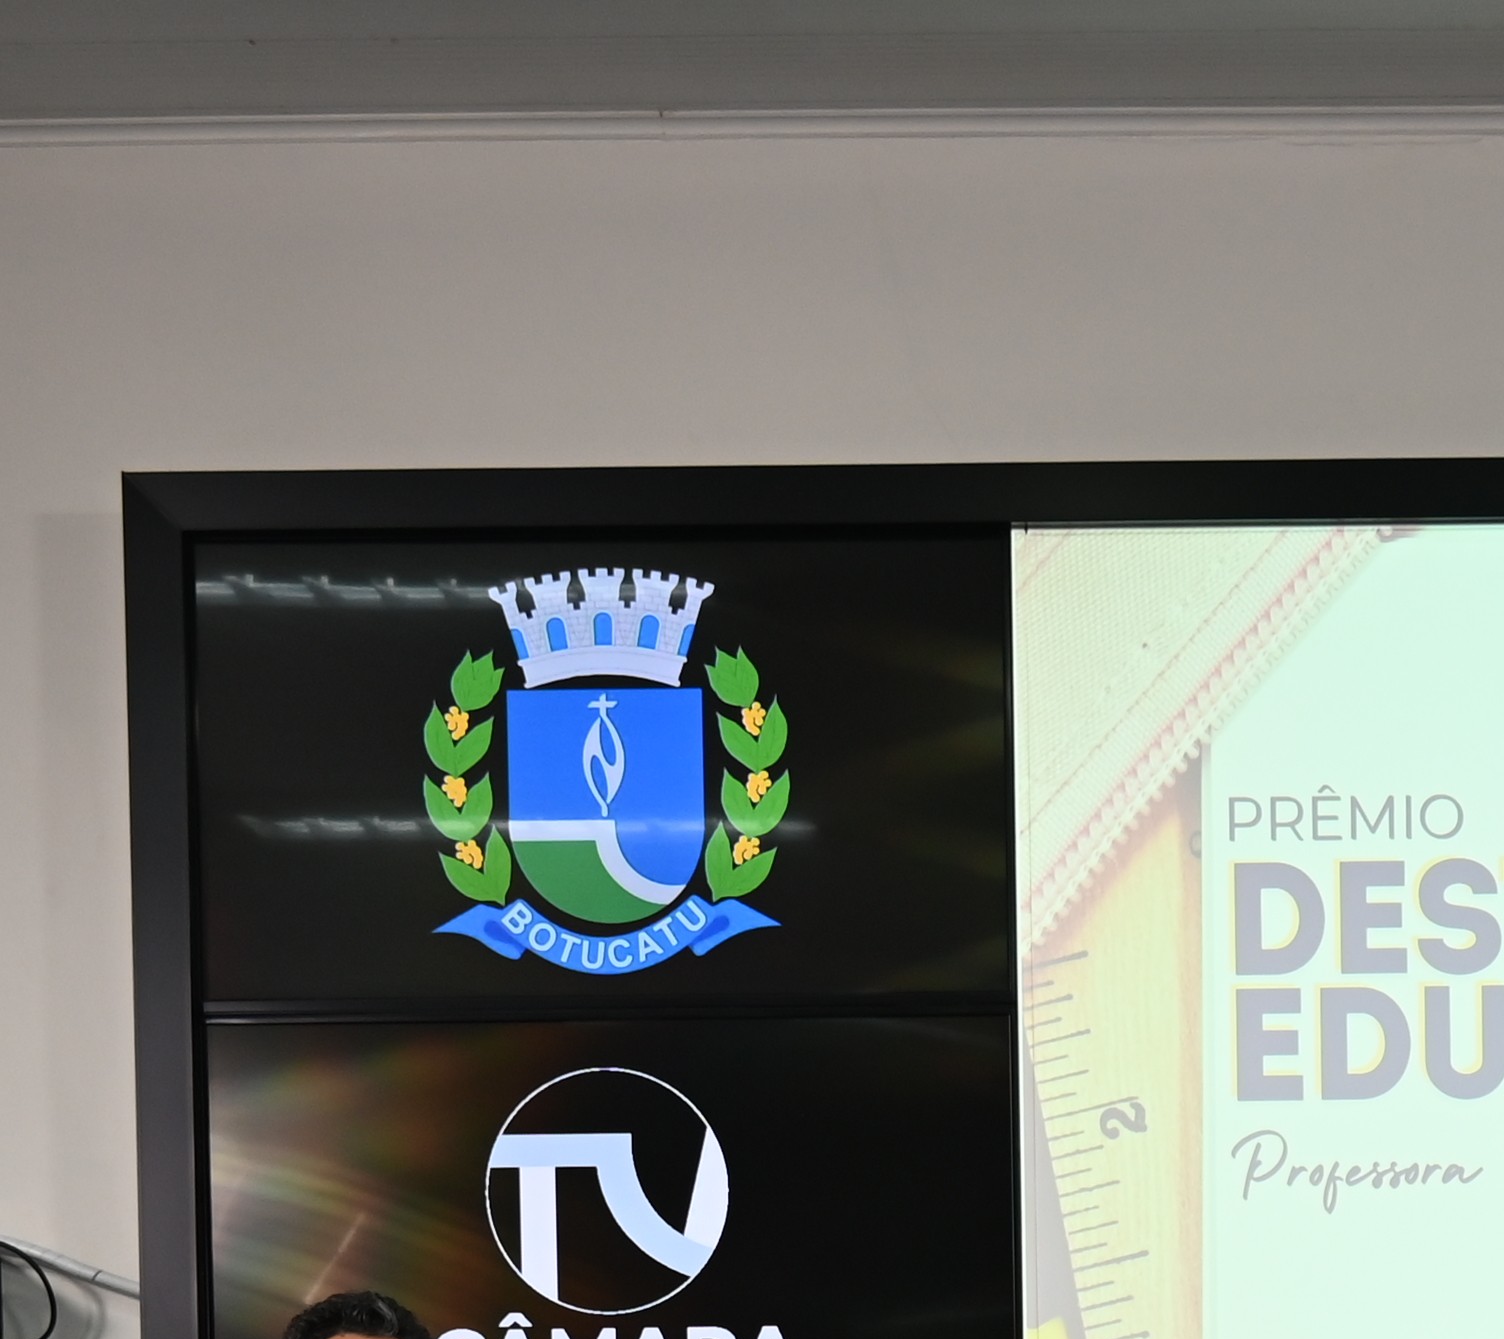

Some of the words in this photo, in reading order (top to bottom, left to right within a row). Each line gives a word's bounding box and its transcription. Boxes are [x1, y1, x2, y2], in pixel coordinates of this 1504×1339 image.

[1228, 786, 1464, 842] PRÊMIO
[502, 900, 707, 968] BOTUCATU
[1232, 1129, 1483, 1215] Professora
[490, 1127, 728, 1300] TV
